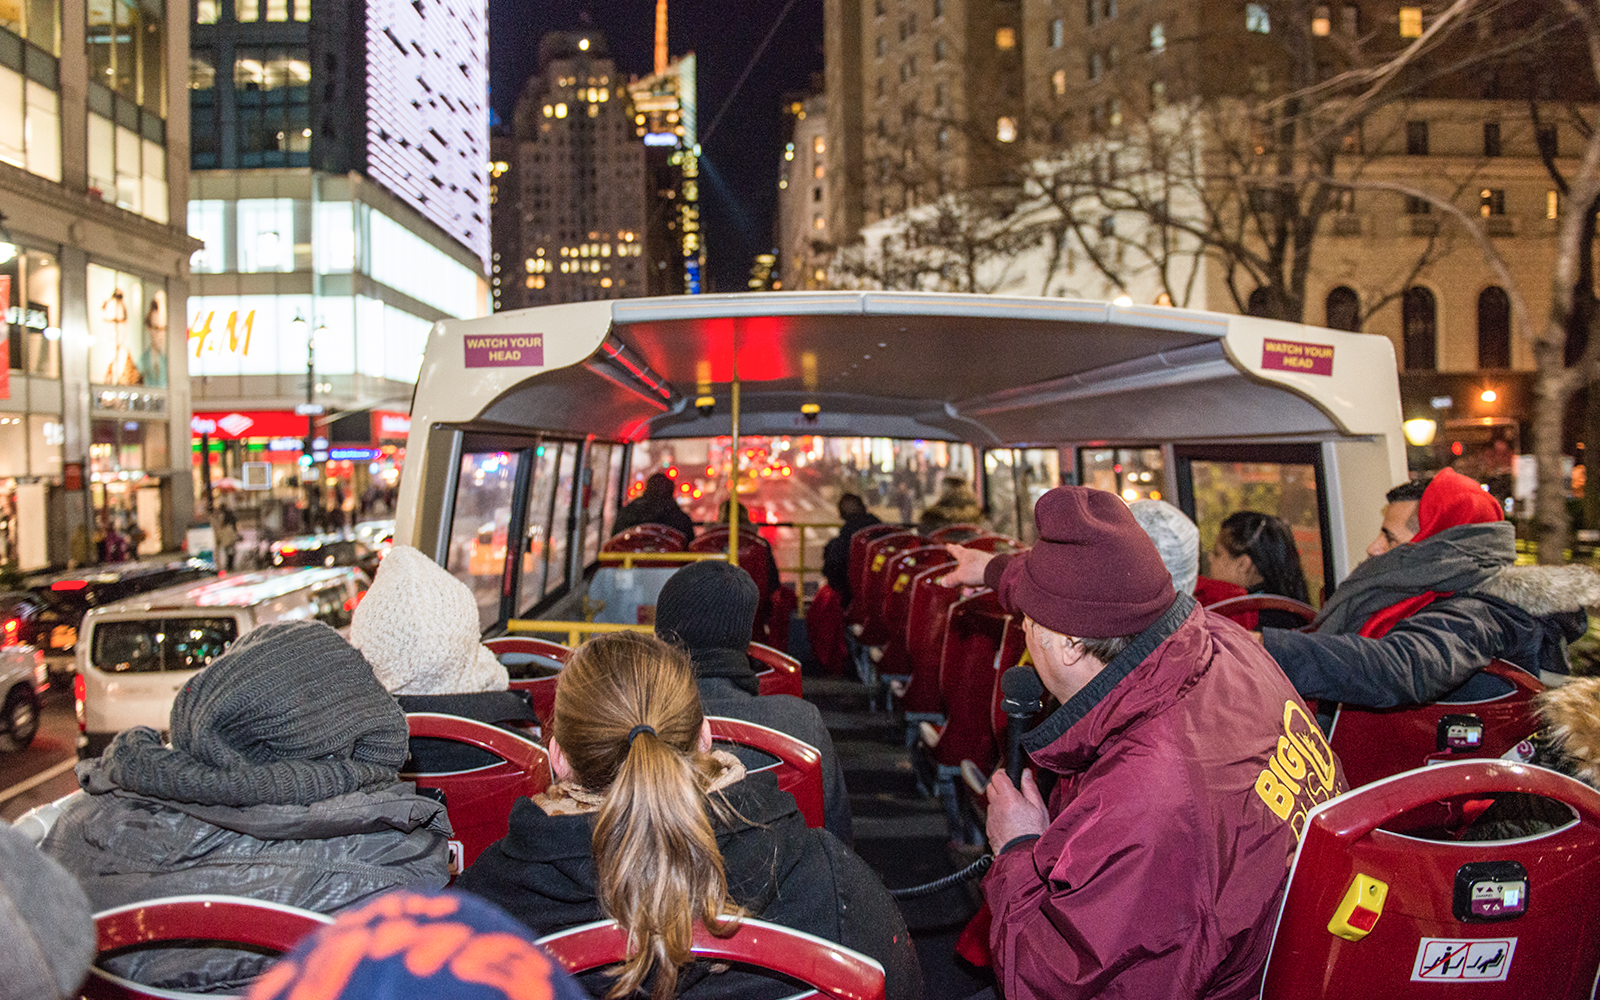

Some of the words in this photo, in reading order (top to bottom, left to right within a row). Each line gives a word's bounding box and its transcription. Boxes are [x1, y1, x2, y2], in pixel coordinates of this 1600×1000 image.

[467, 338, 508, 349] WATCH
[510, 337, 541, 348] YOUR
[489, 350, 521, 361] HEAD
[1265, 342, 1303, 355] WATCH
[1304, 345, 1333, 358] YOUR
[1283, 356, 1314, 369] HEAD
[1255, 735, 1306, 820] BIG
